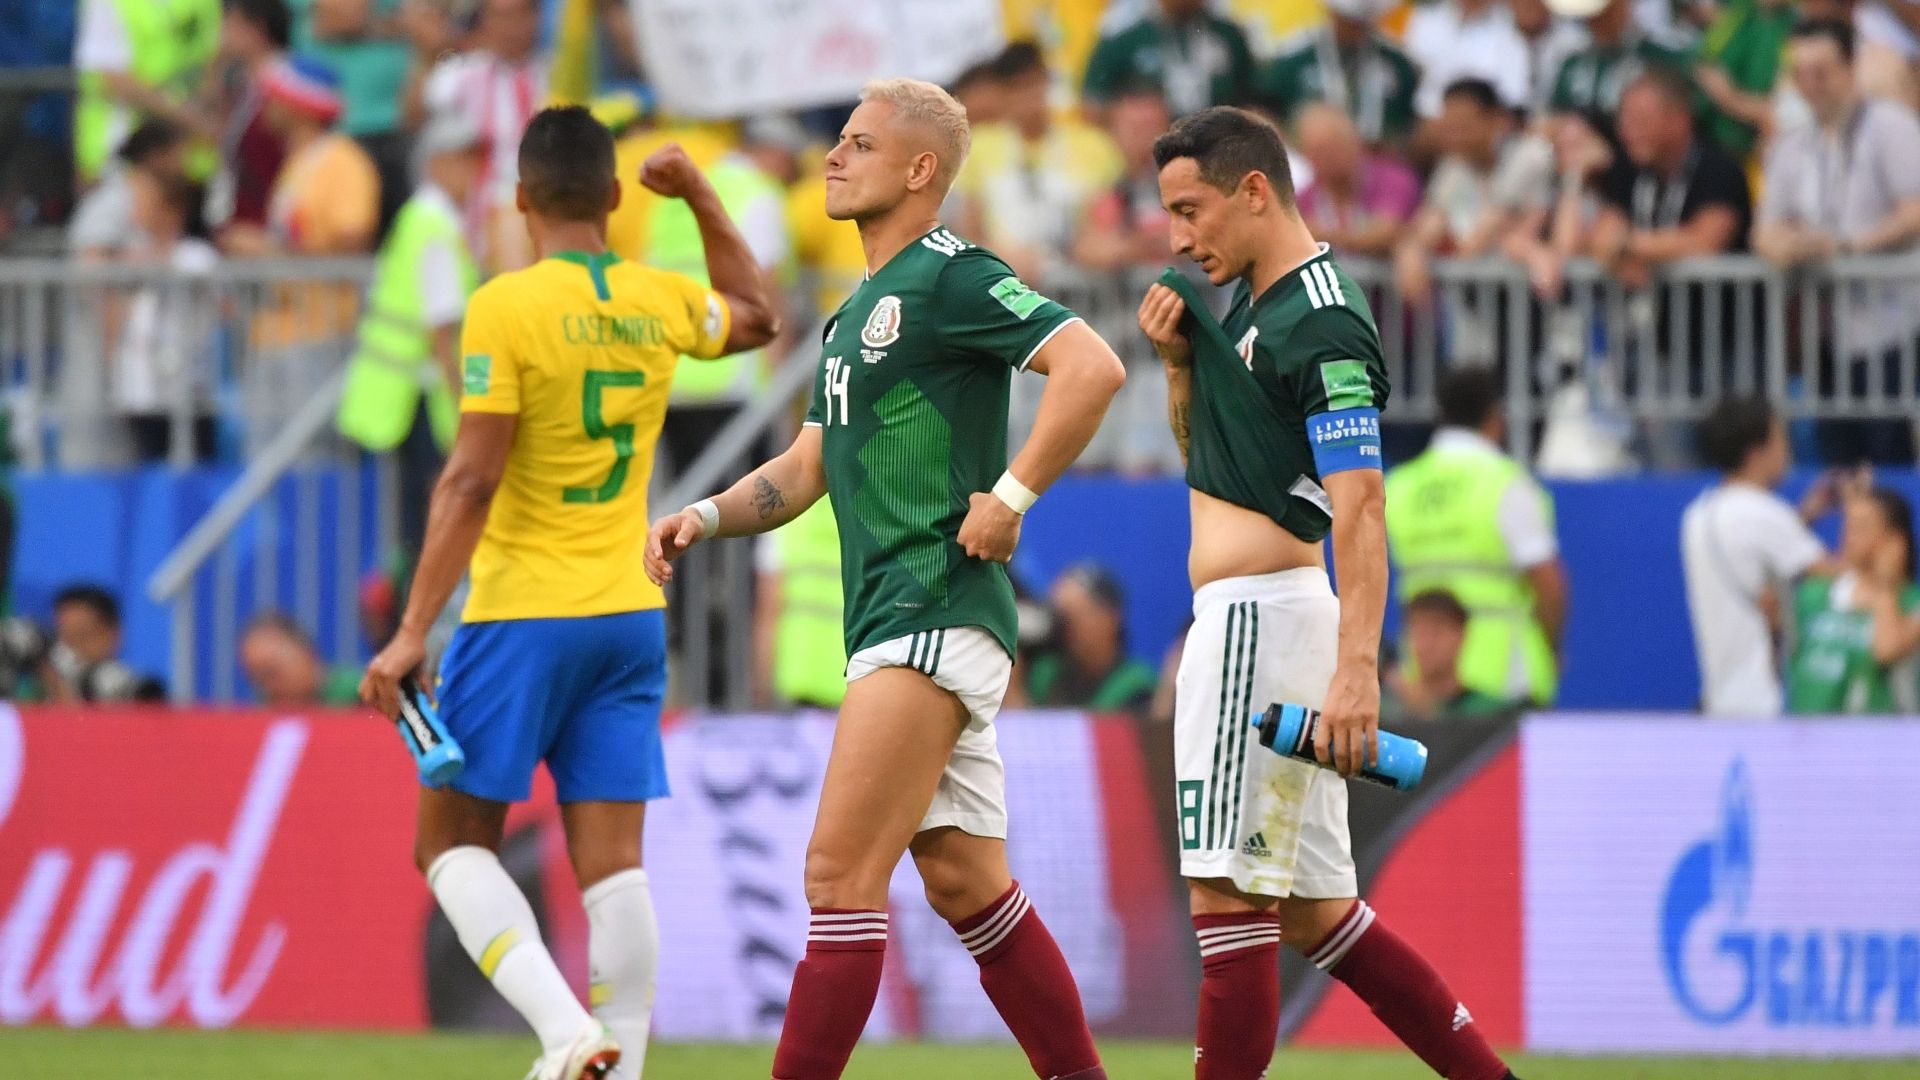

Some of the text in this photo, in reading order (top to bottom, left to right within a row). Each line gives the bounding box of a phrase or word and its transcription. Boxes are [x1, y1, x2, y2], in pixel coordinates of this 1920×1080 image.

[562, 314, 665, 346] CASEMIRO
[825, 355, 851, 427] 14
[562, 369, 645, 504] 5
[1316, 416, 1377, 434] LIVING
[1178, 780, 1205, 850] 8
[1241, 846, 1272, 858] adidas
